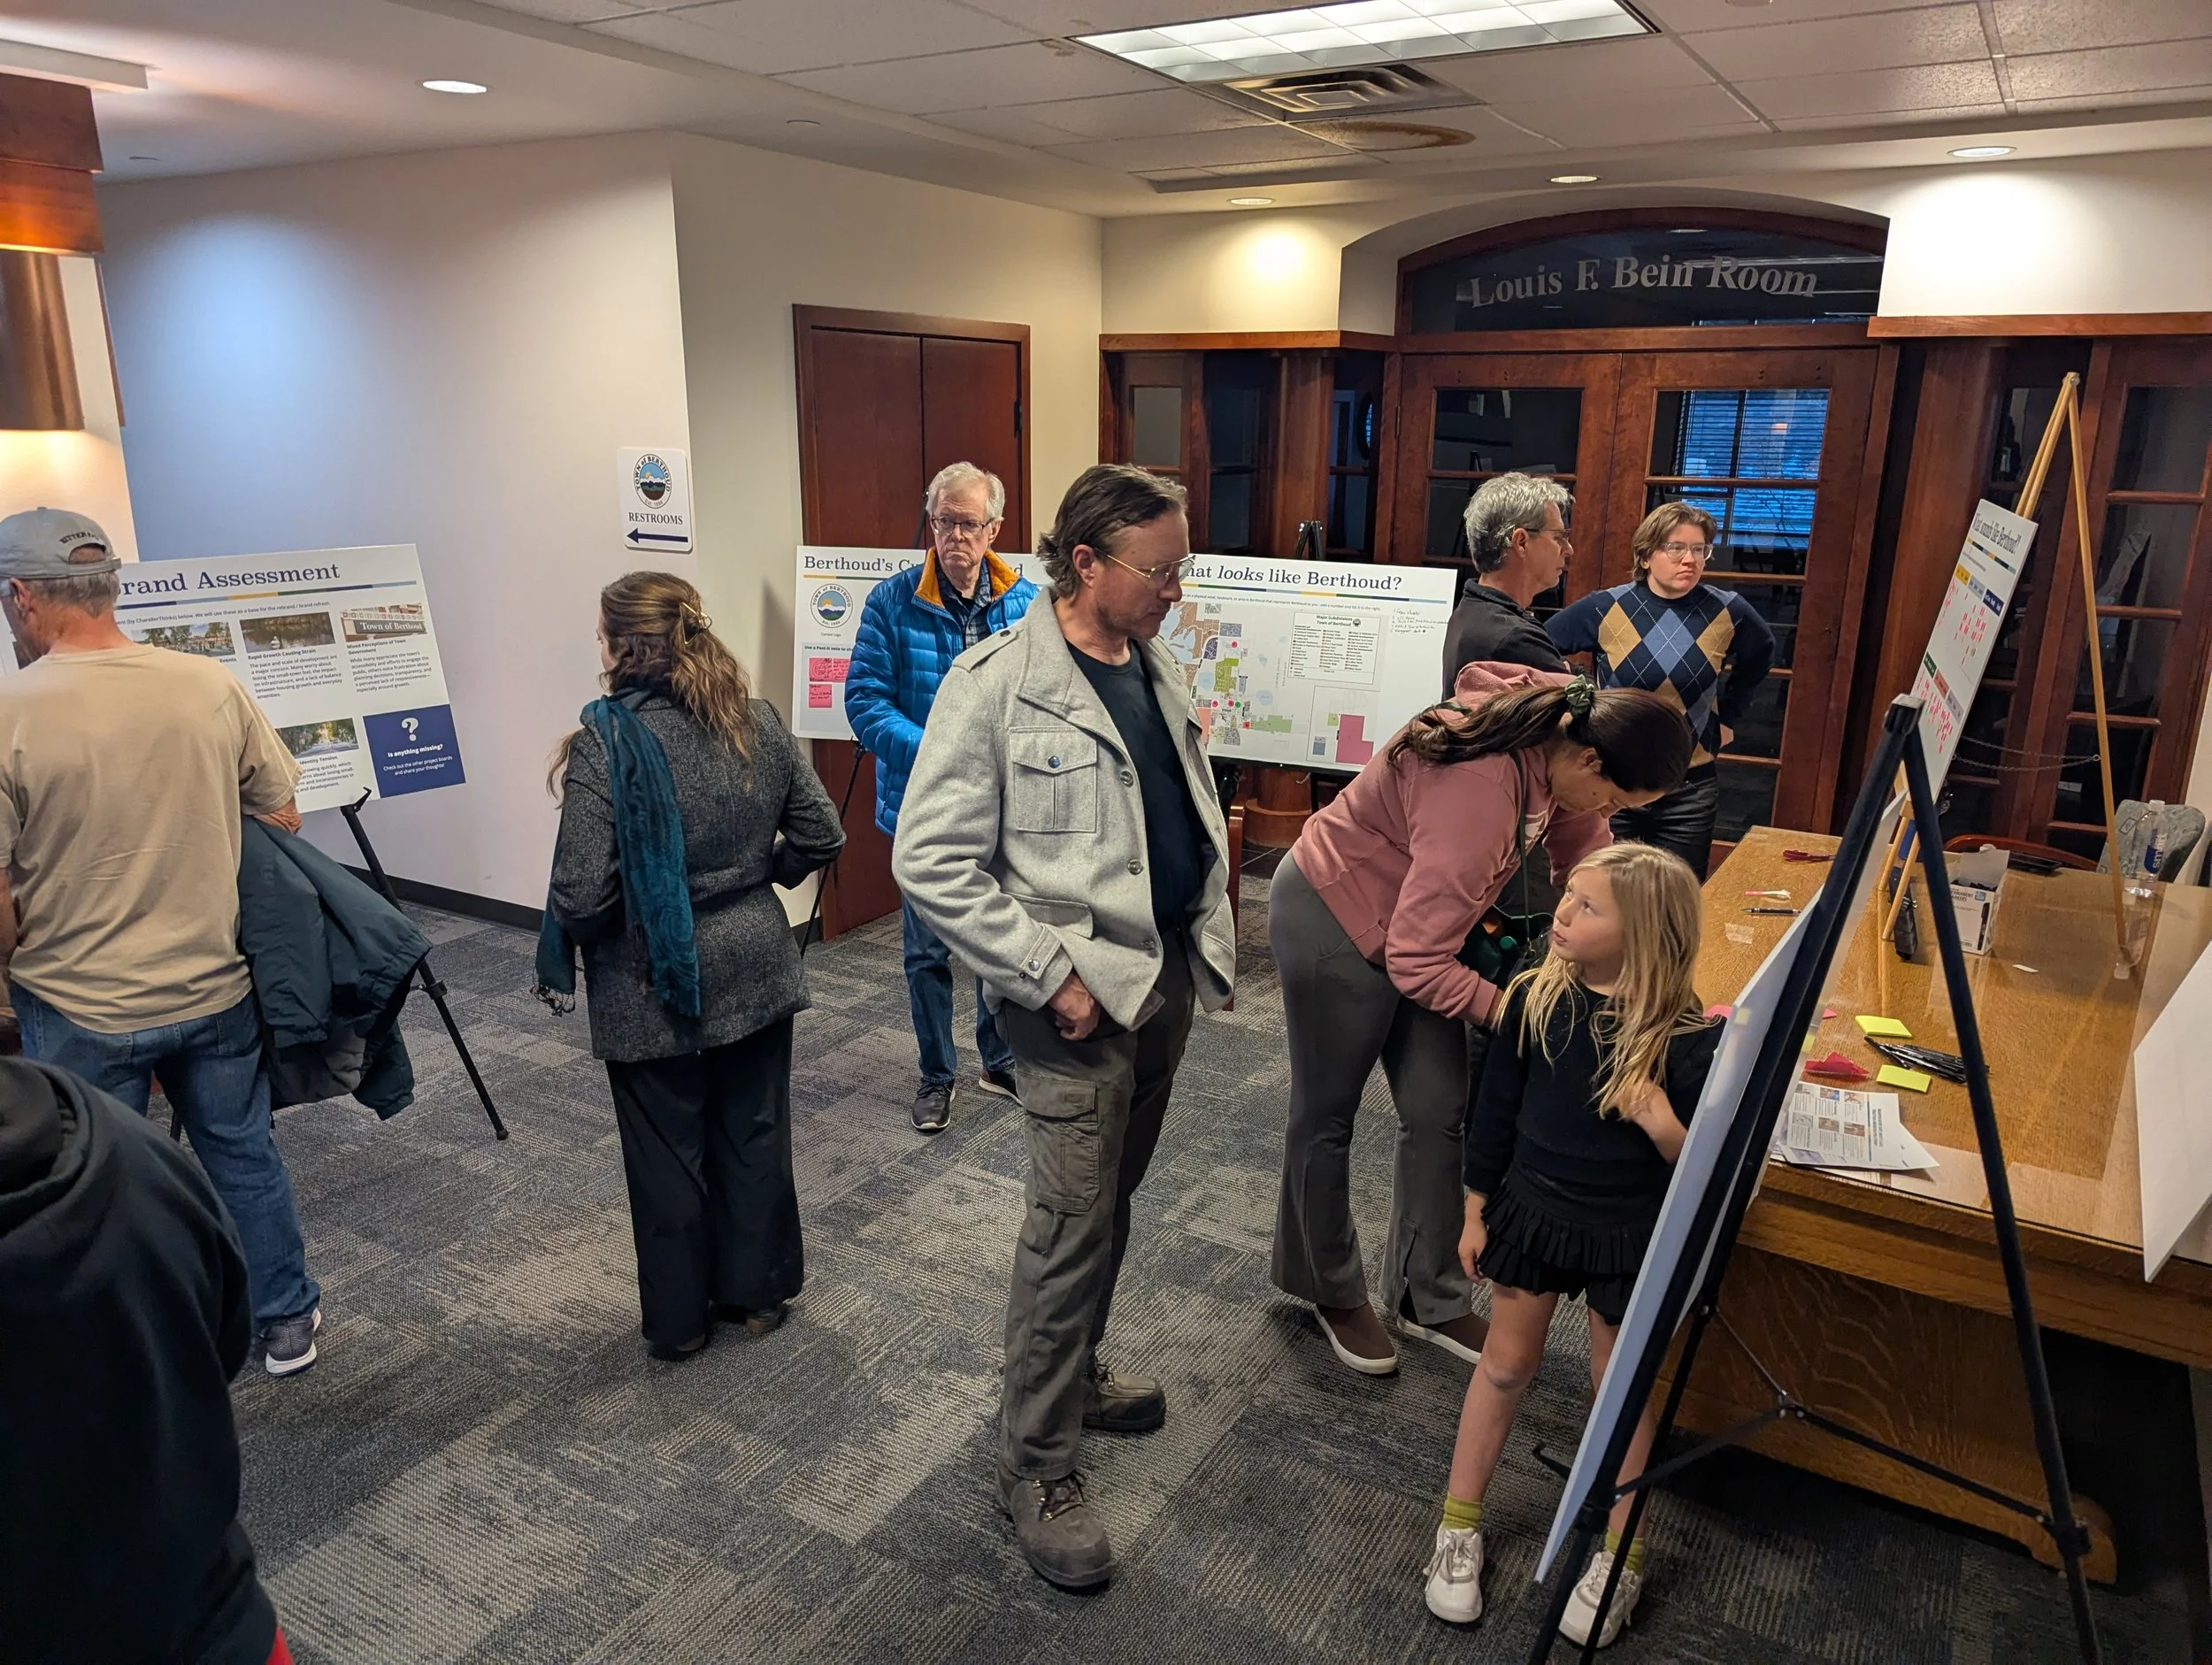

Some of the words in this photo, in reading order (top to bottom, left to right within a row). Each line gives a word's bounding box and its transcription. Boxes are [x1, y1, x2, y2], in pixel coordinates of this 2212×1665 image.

[1470, 265, 1563, 308] Louis
[1575, 259, 1599, 292] F.
[1611, 254, 1693, 288] Bein
[1707, 256, 1818, 298] Room
[647, 456, 672, 492] BERTHOUD
[628, 512, 683, 526] RESTROOMS
[803, 555, 894, 572] Berthoud's
[121, 572, 188, 595] rand
[196, 564, 342, 589] Assessment
[1217, 565, 1263, 582] looks
[1268, 568, 1302, 585] like
[1306, 571, 1402, 591] Berthoud?
[812, 591, 822, 606] TOWN
[829, 586, 851, 608] BERTHOUD
[359, 621, 384, 631] Town
[385, 621, 392, 631] of
[393, 621, 423, 631] Berthoud
[394, 748, 419, 757] anything
[419, 743, 443, 753] missing?
[315, 774, 349, 783] inconsistencies
